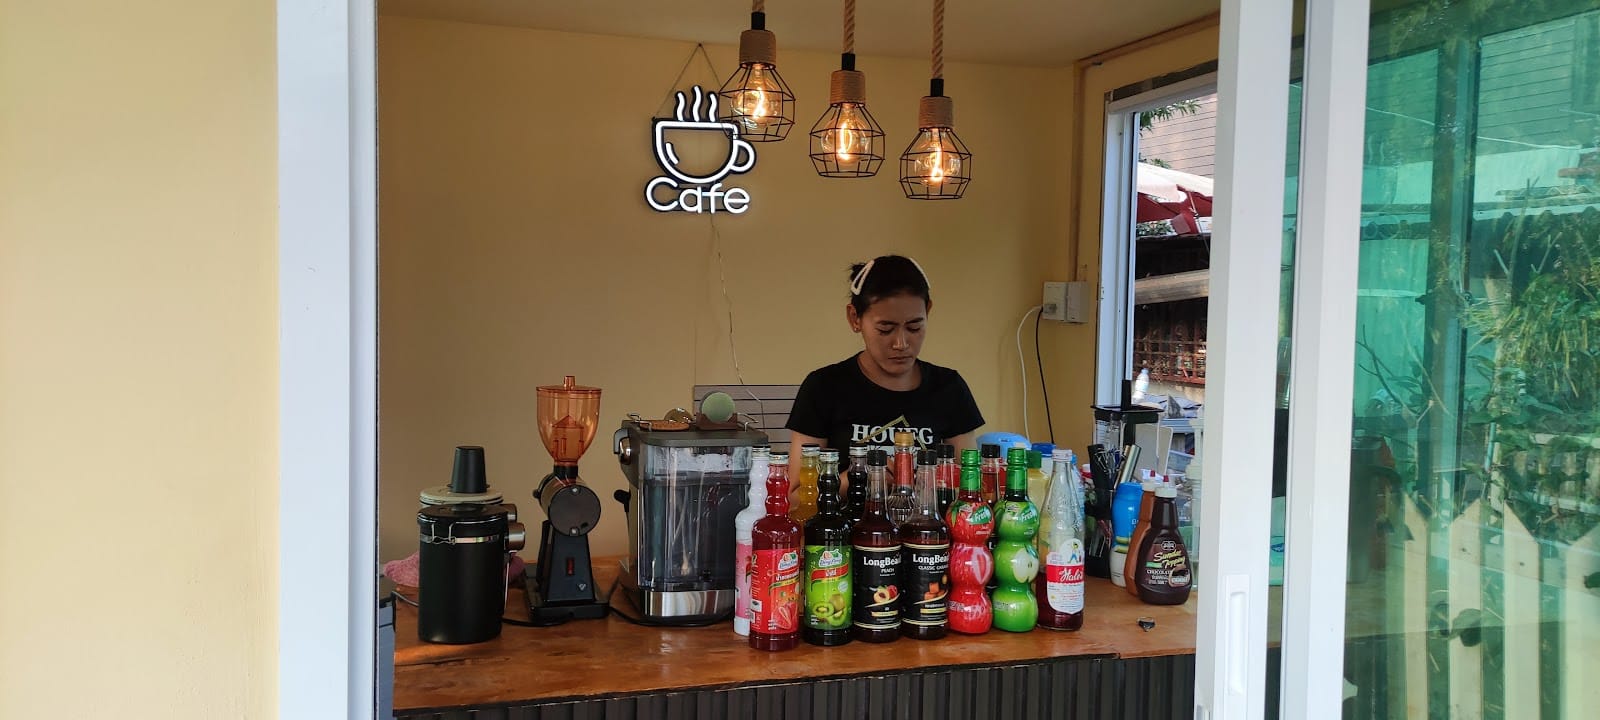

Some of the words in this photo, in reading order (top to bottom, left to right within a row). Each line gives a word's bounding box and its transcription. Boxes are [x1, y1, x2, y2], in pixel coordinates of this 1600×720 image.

[645, 176, 750, 214] Cafe
[863, 555, 902, 569] LongBea
[912, 552, 949, 566] LongBea
